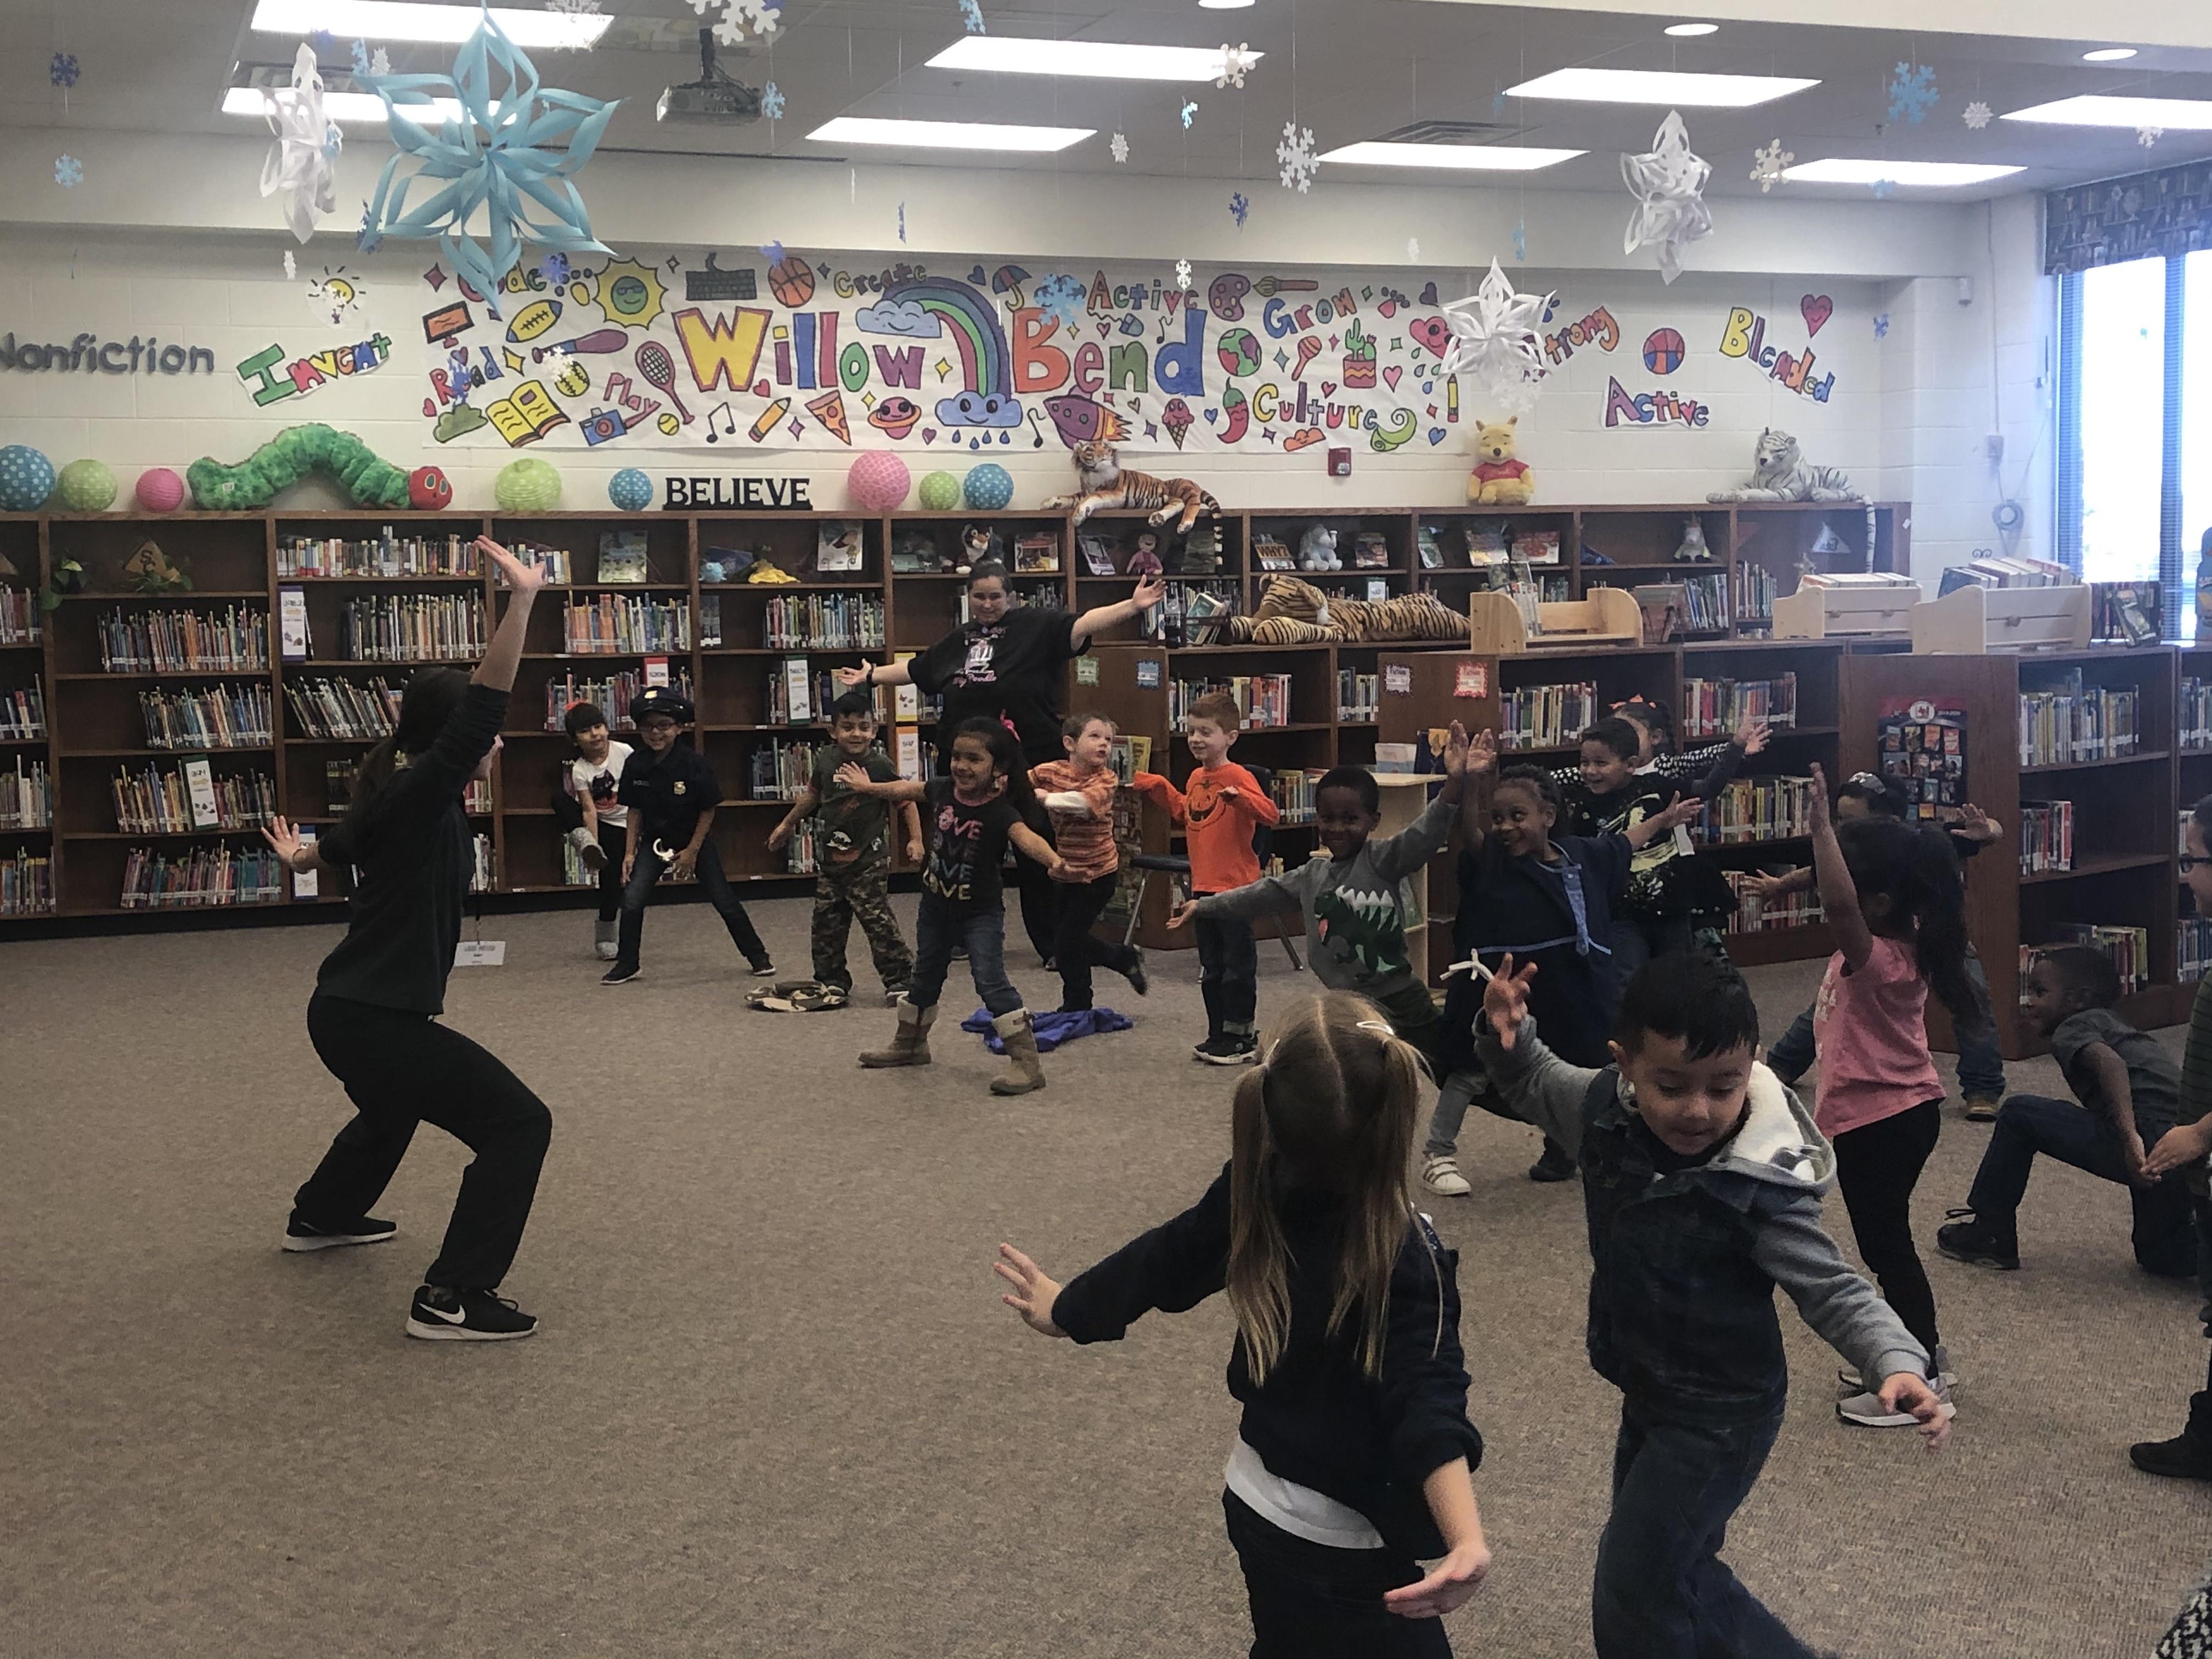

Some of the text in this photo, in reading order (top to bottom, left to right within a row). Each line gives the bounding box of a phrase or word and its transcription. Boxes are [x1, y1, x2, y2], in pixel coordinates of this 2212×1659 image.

[833, 263, 927, 298] Create
[1087, 270, 1199, 315] Active
[1263, 287, 1357, 338] Grow
[236, 332, 392, 407] Invent
[429, 346, 505, 405] Rad
[672, 306, 1207, 397] Willow Bend
[1719, 306, 1836, 403] Blended
[603, 372, 662, 430] Play
[1252, 381, 1378, 430] Culture
[1605, 375, 1709, 427] Active
[665, 477, 810, 506] BELIEVE
